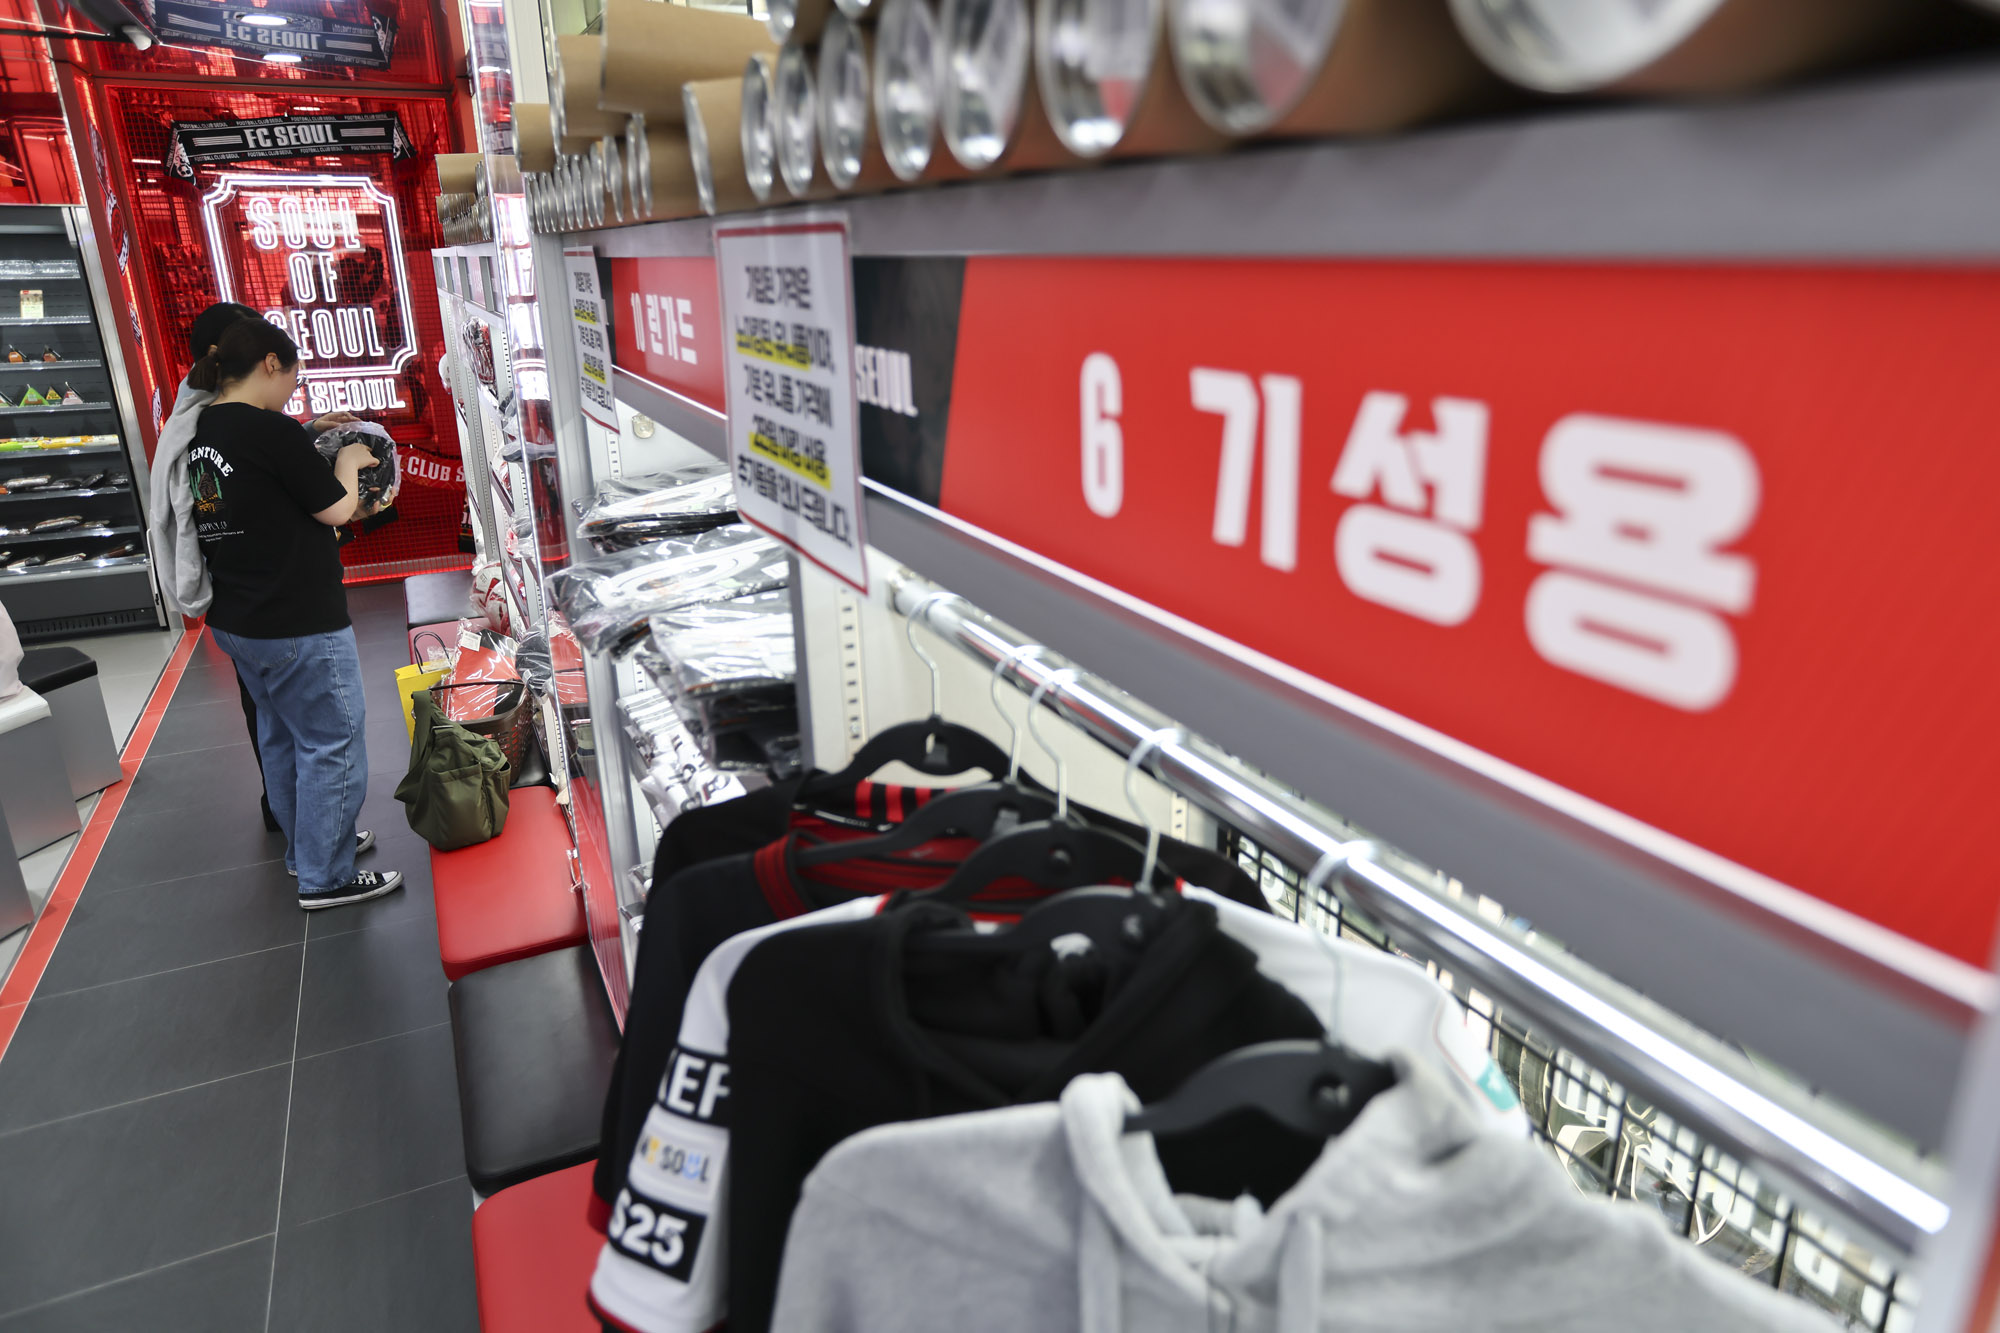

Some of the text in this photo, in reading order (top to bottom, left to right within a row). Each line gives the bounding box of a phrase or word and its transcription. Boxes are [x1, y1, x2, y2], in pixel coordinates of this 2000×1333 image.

[243, 124, 338, 149] FC SEOUL
[249, 197, 361, 250] SOUL
[288, 252, 338, 304] OF
[646, 294, 698, 365] 린가드
[308, 378, 406, 414] SEOUL
[408, 456, 451, 482] CLUB
[1080, 351, 1762, 713] 6 기성용
